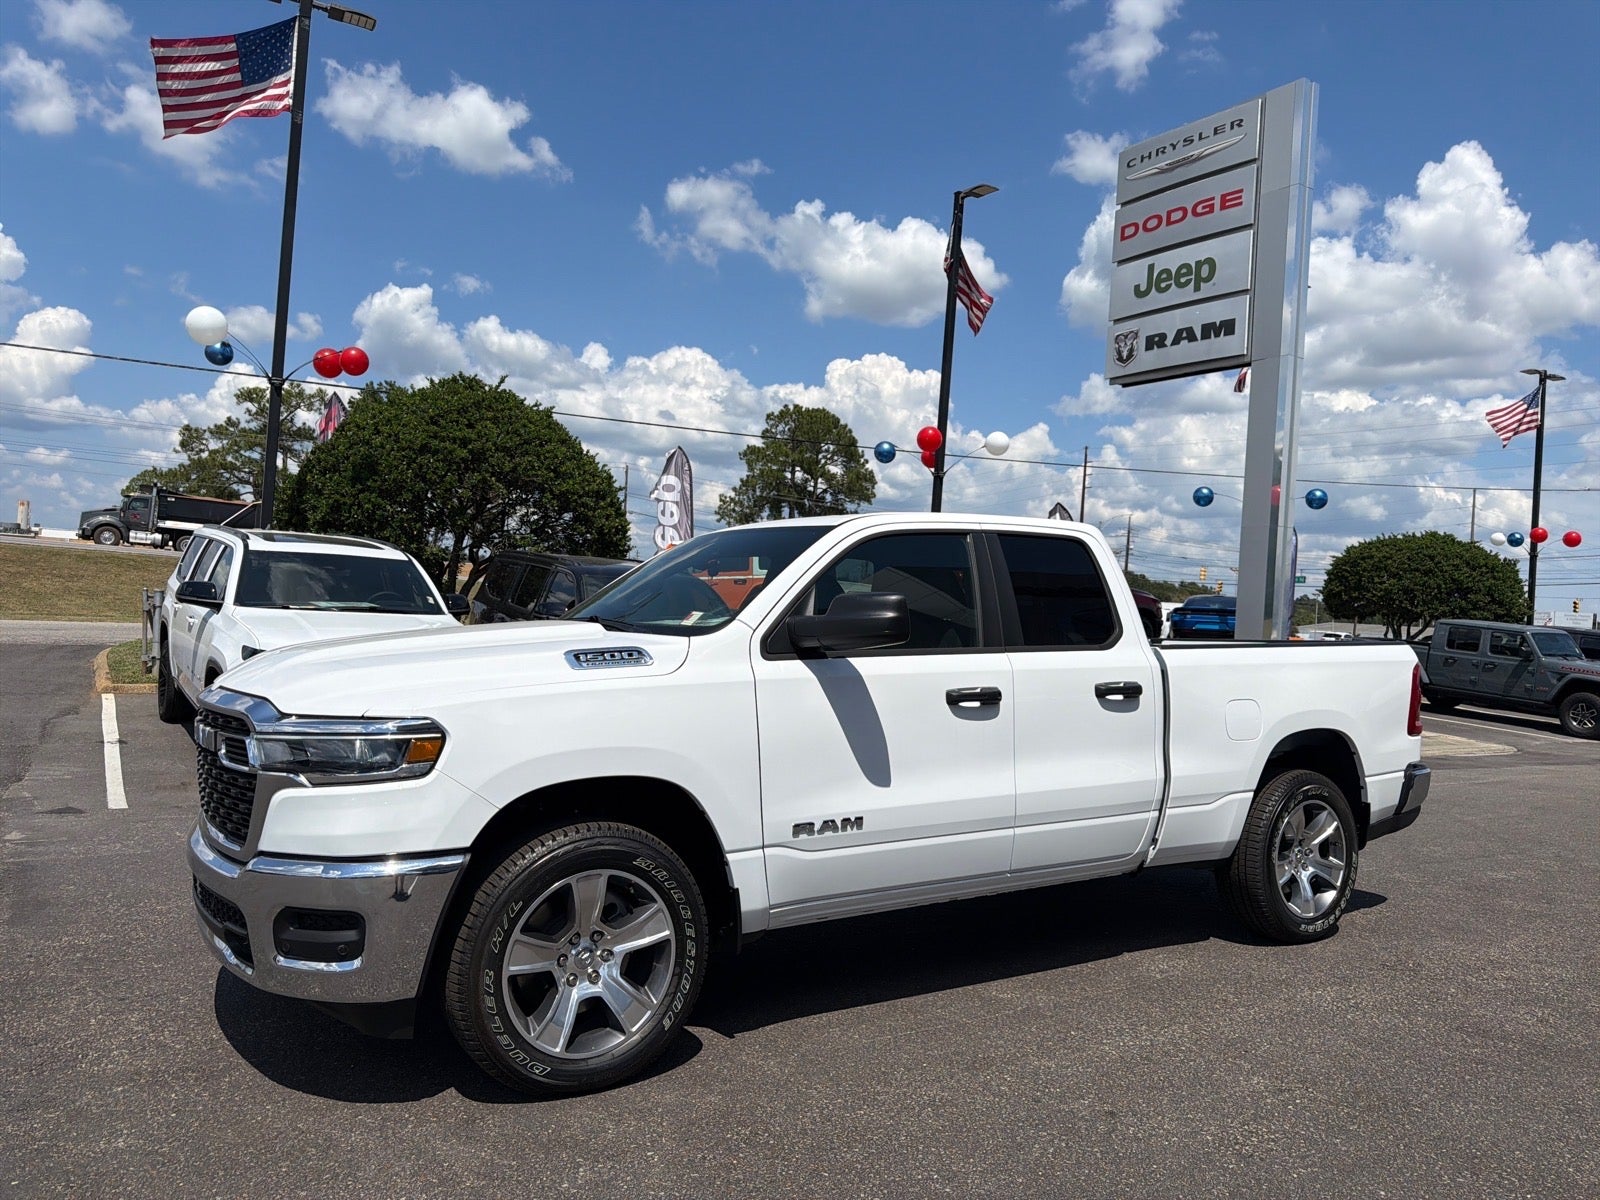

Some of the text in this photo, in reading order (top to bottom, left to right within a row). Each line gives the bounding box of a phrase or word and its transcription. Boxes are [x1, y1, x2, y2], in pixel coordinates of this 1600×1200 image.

[1126, 118, 1244, 168] CHRYSLER
[1120, 188, 1244, 242] DODGE
[1133, 256, 1217, 299] Jeep
[1145, 318, 1236, 351] RAM
[577, 651, 639, 662] 1500
[792, 816, 863, 838] RAM
[633, 857, 696, 1031] BRIDGESTONE
[484, 900, 551, 1075] DUELER H/L
